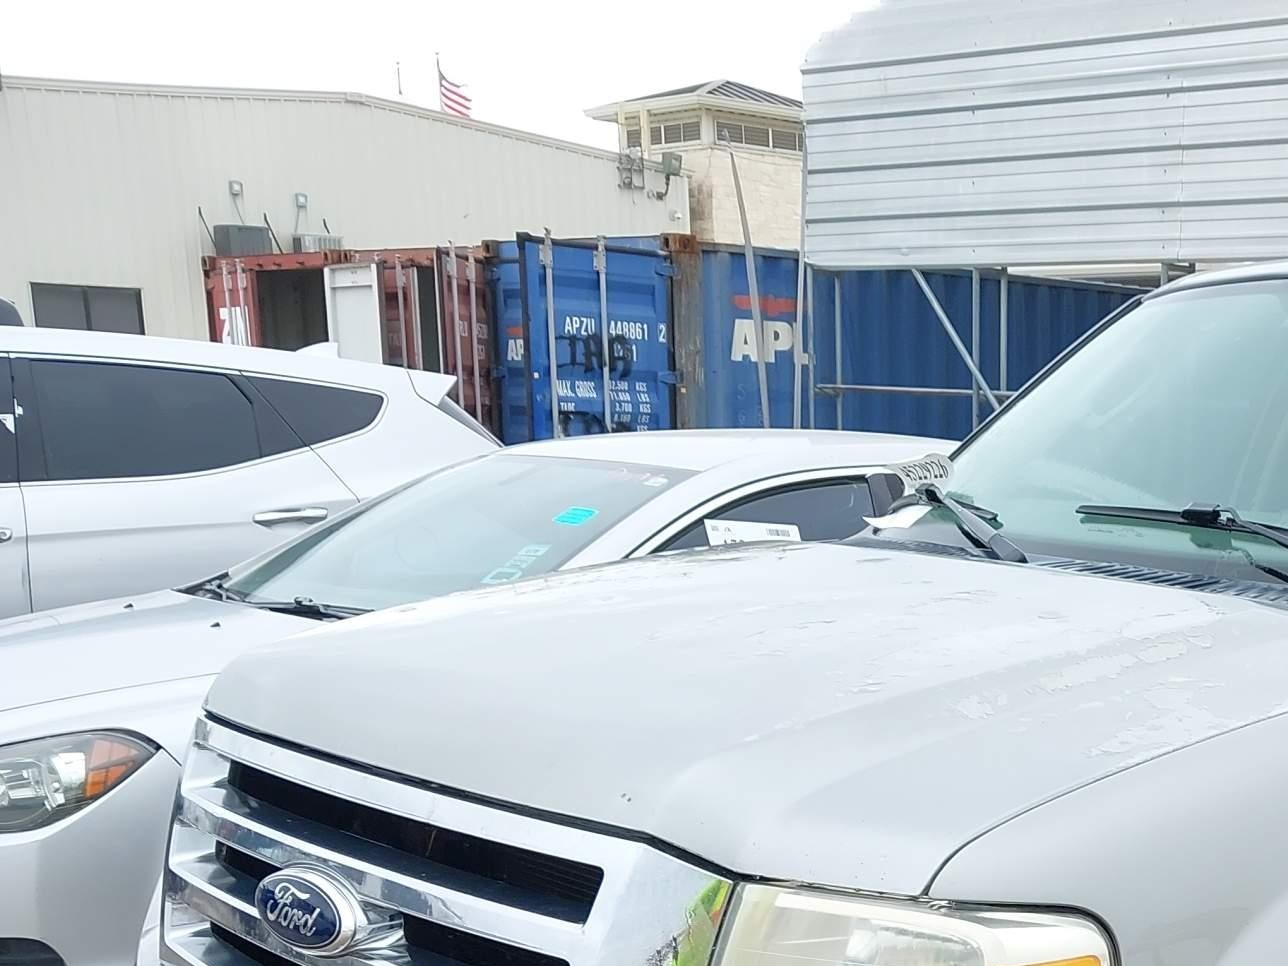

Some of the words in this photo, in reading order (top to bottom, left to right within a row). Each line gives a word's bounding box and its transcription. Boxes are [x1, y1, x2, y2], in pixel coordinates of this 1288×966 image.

[565, 316, 595, 335] APZU
[610, 321, 648, 340] 448861
[575, 380, 597, 398] GROSS
[899, 459, 949, 481] 45229226
[266, 883, 320, 937] Ford
